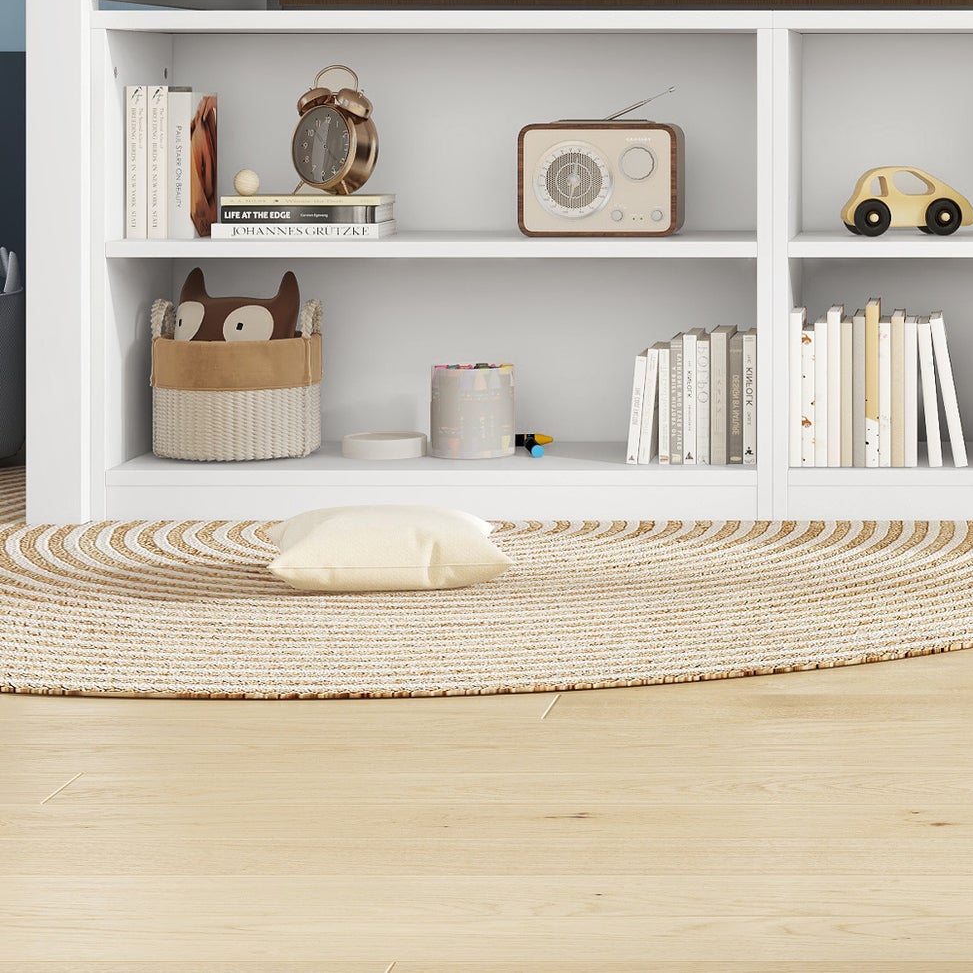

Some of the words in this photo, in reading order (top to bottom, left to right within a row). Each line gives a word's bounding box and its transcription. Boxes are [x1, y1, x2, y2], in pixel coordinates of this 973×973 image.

[224, 211, 241, 219] LIFE
[242, 211, 252, 219] AT
[253, 211, 269, 219] THE
[269, 211, 291, 219] EDGE
[231, 227, 302, 236] JOHANNES
[305, 225, 370, 236] GRÜTZKE
